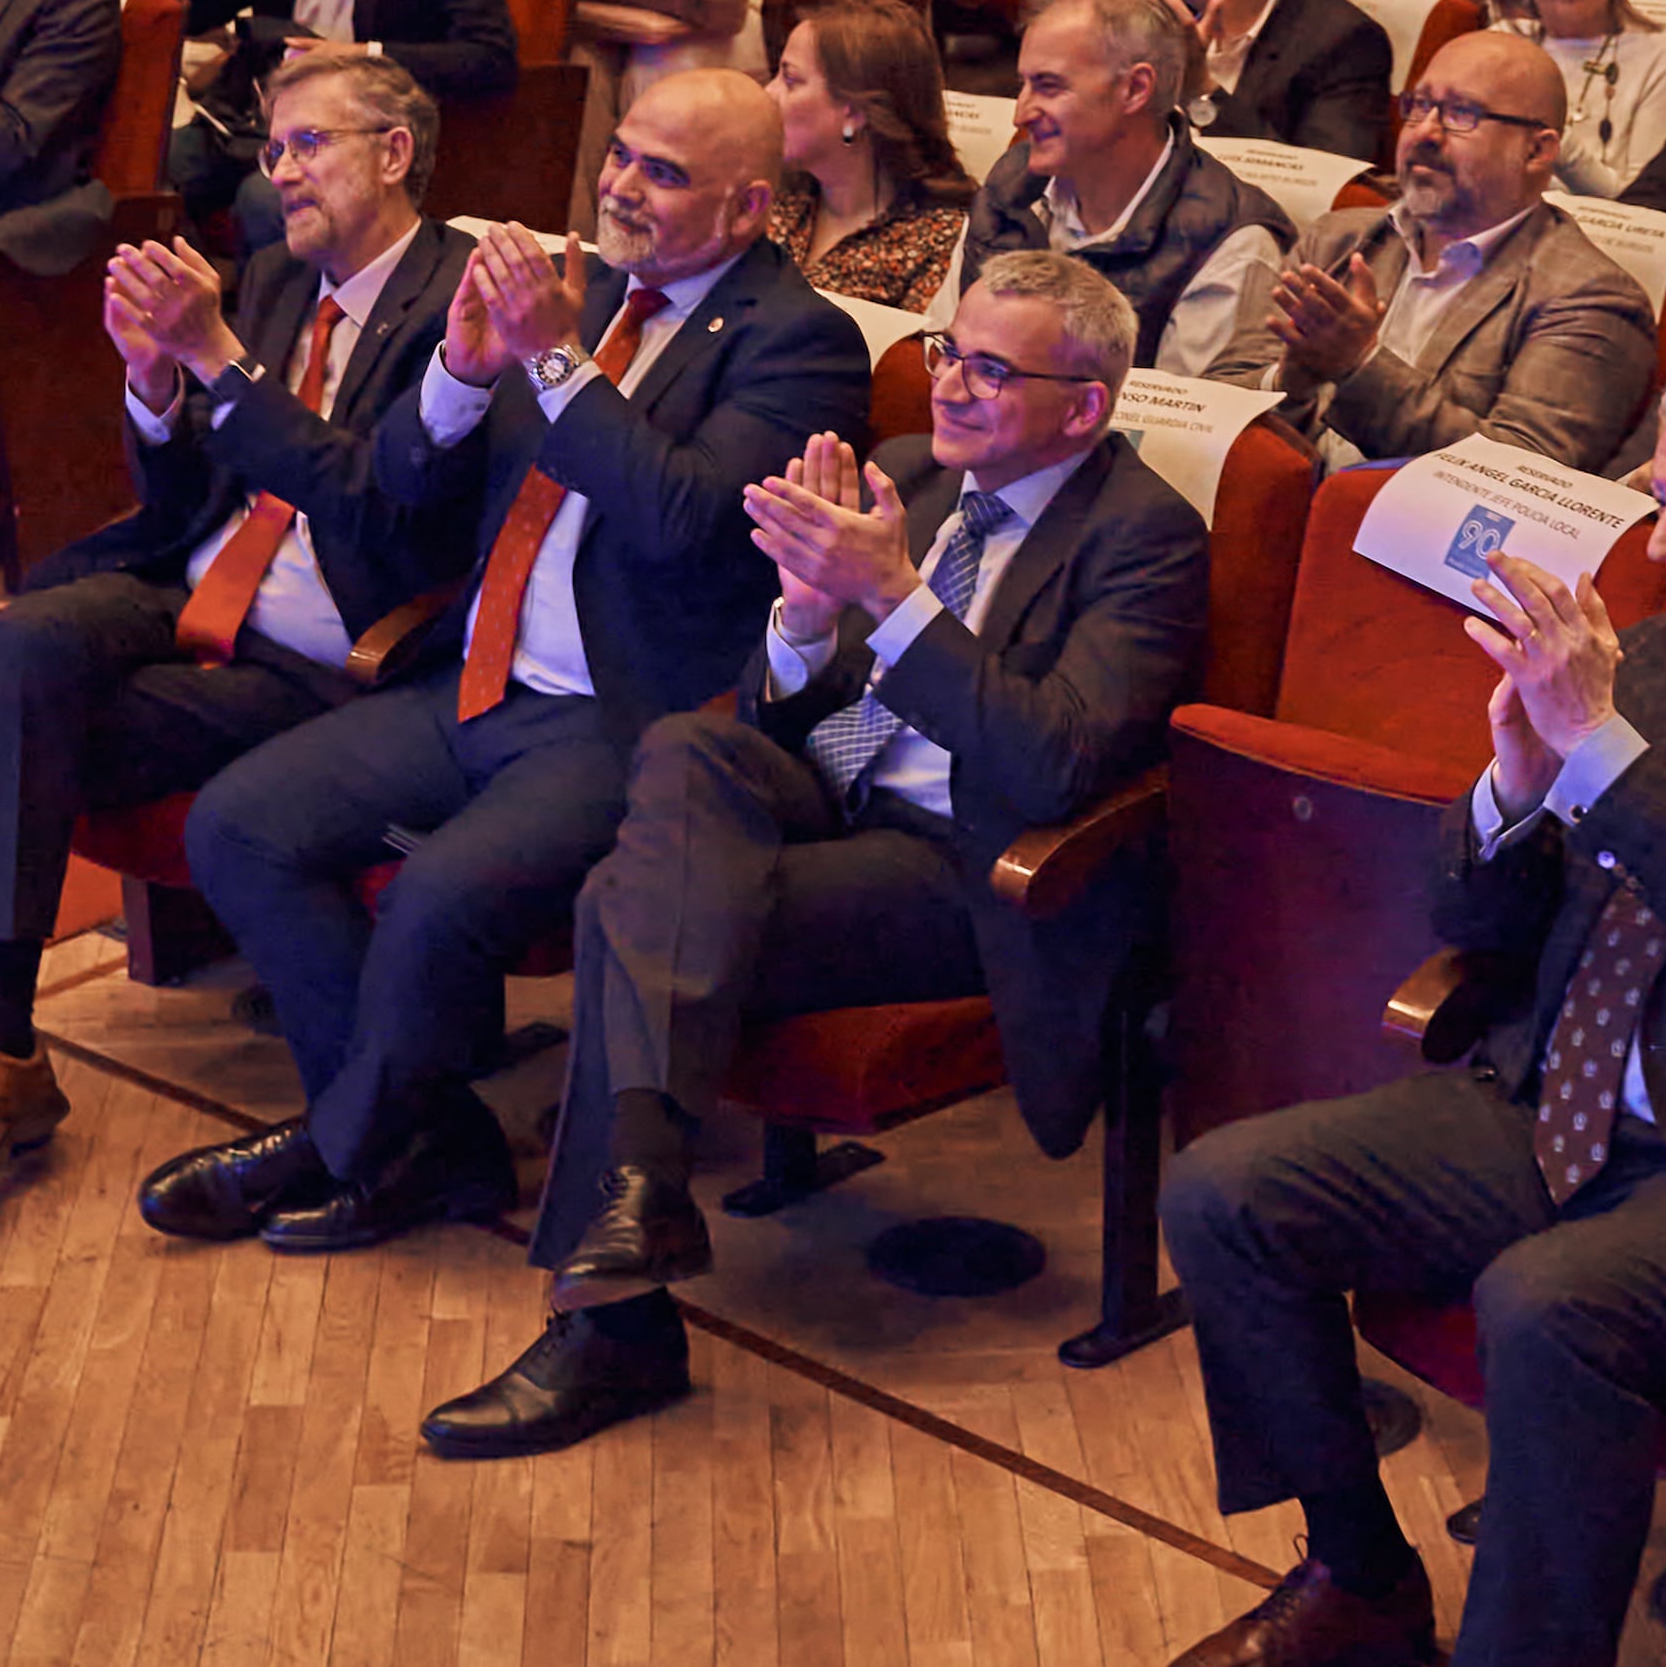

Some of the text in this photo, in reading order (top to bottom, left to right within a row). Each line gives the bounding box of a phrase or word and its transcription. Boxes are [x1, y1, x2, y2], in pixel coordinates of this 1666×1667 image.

[1148, 396, 1207, 412] MARTIN
[1467, 464, 1508, 484] ANGEL
[1509, 477, 1559, 503] GARCIA
[1557, 494, 1626, 530] LLORENTE
[1517, 464, 1574, 490] RESERVADO
[1433, 470, 1491, 499] INTENDENTE
[1490, 491, 1514, 512] JEFE
[1512, 500, 1552, 526] POLICIA
[1549, 517, 1582, 541] LOCAL
[1458, 519, 1501, 561] 90
